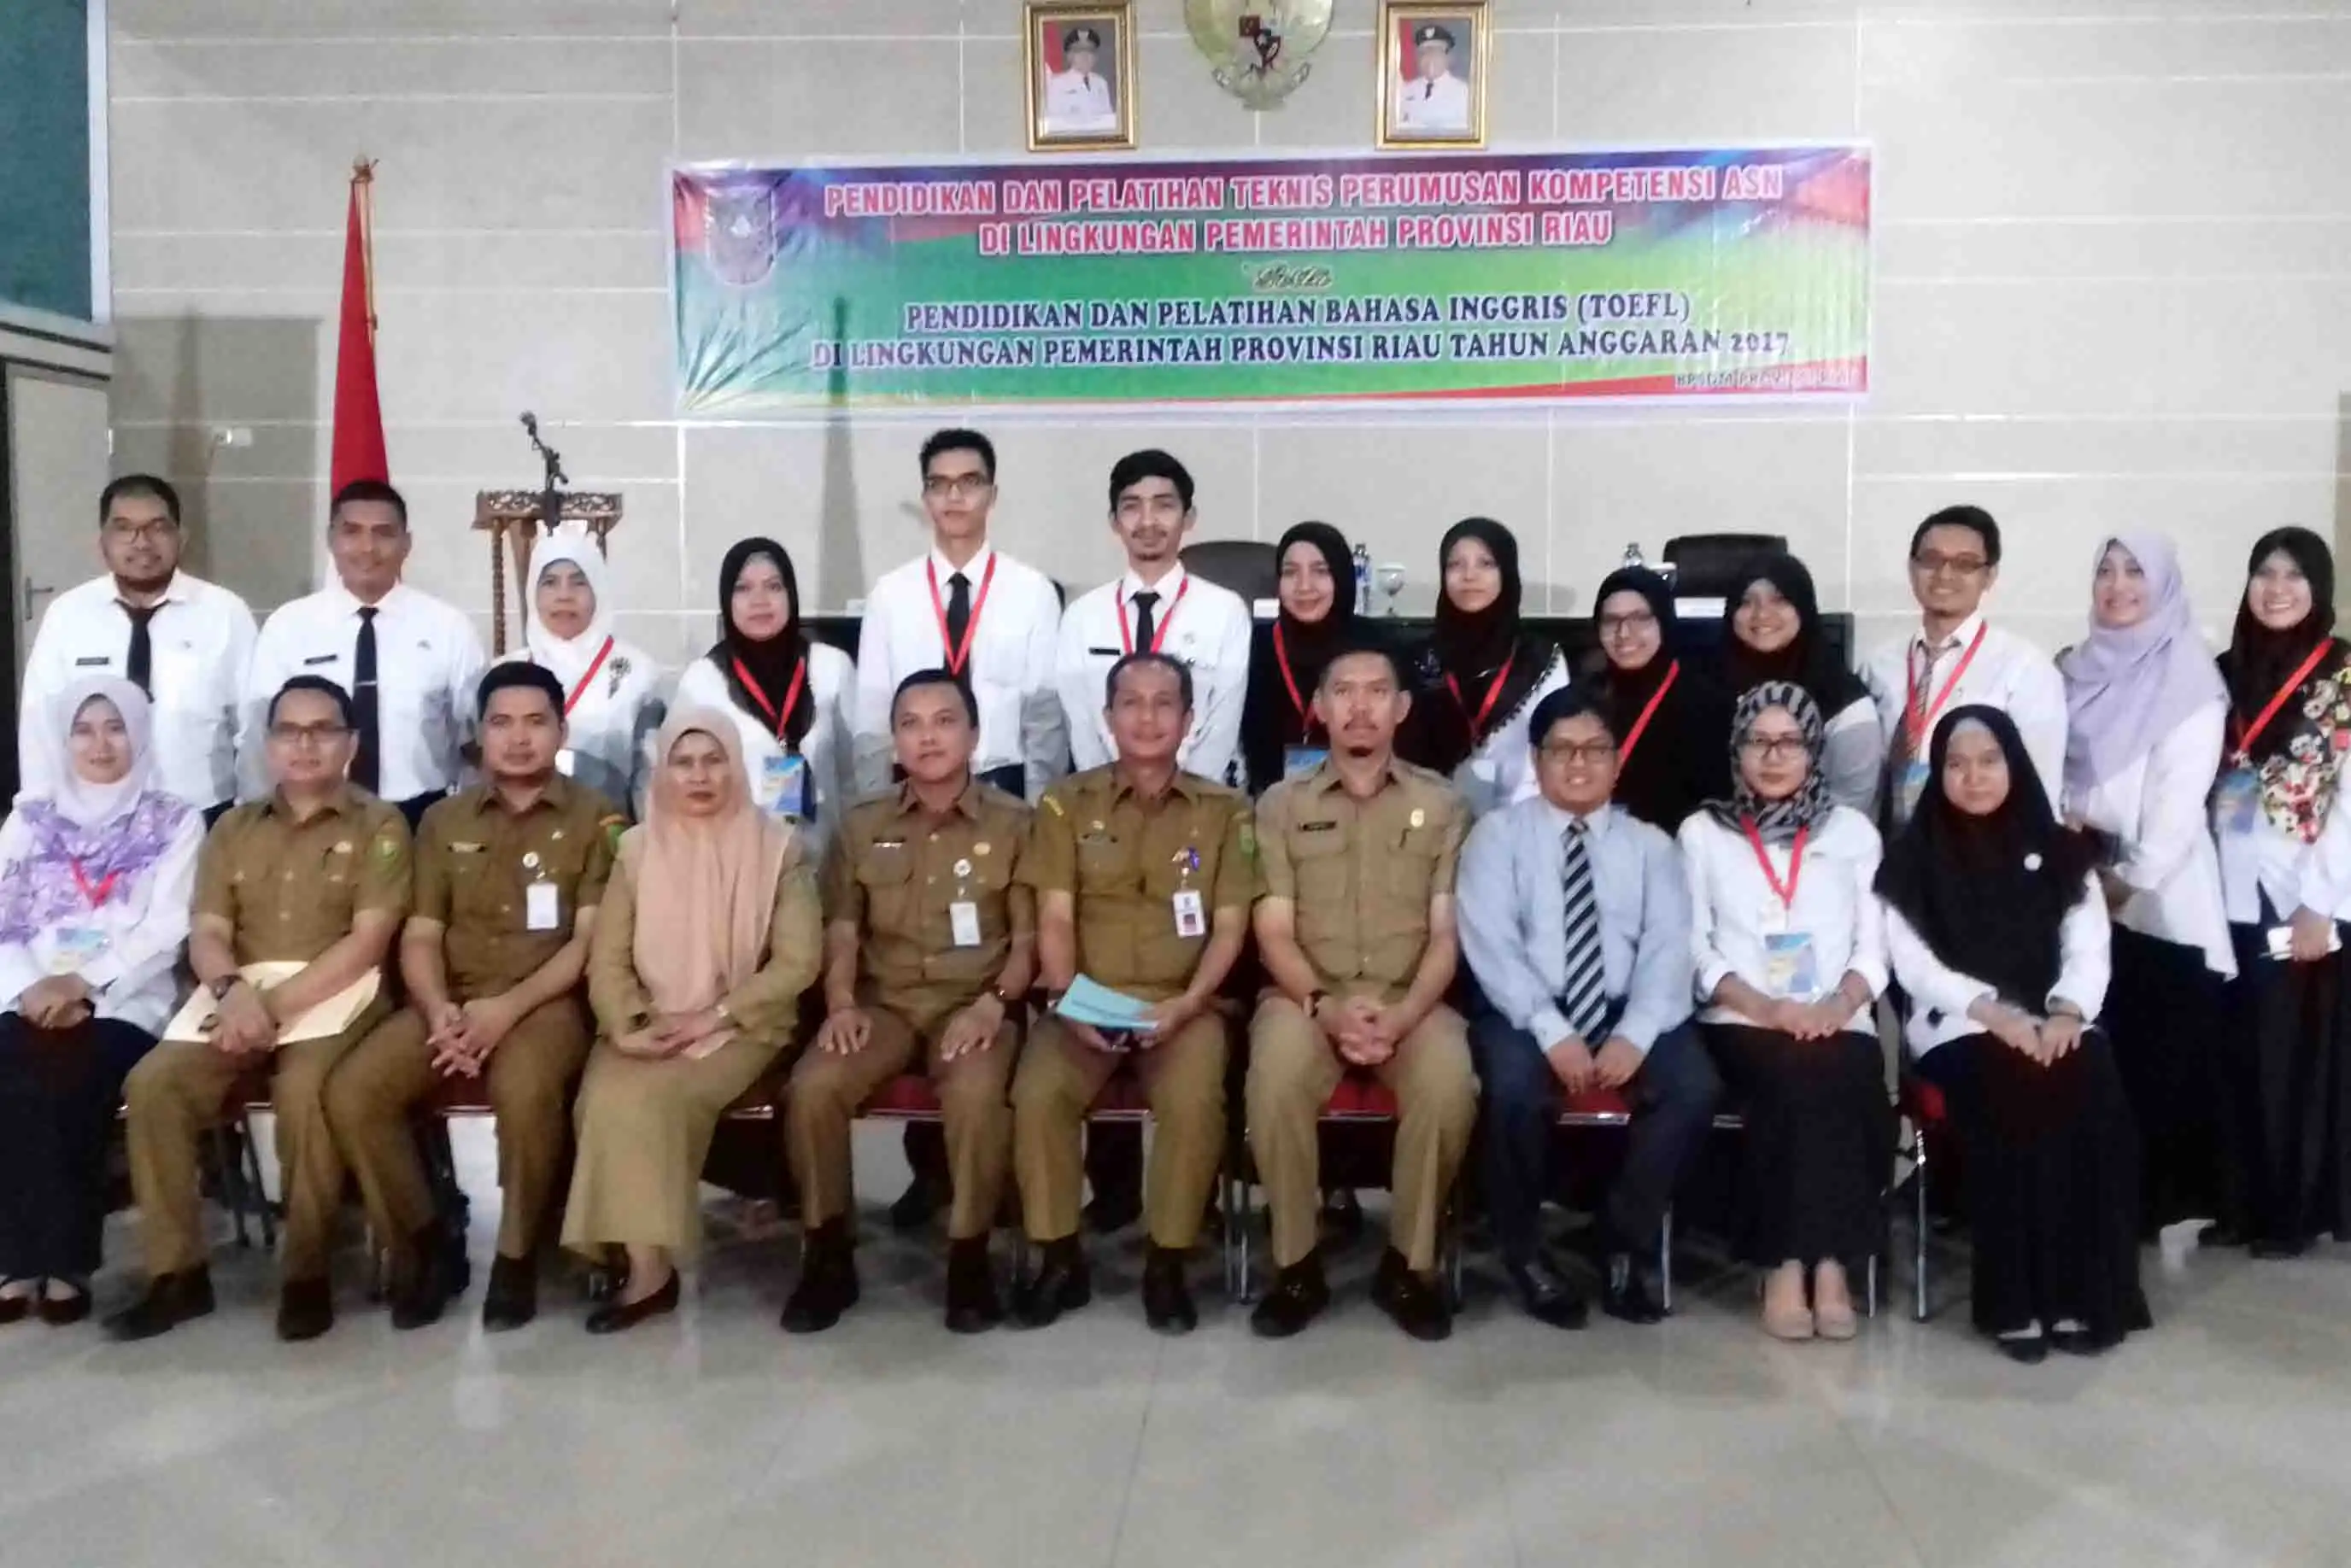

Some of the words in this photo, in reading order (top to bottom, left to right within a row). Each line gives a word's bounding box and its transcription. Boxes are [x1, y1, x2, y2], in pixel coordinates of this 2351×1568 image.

[825, 183, 995, 215] PENDIDIKAN
[1004, 181, 1061, 212] DAN
[1070, 178, 1223, 211] PELATIHAN
[1230, 175, 1332, 208] TEKNIS
[1341, 173, 1519, 207] PERUMUSAN
[1530, 167, 1714, 202] KOMPETENSI
[1723, 166, 1782, 200] ASN
[980, 224, 1010, 254] DI
[1018, 220, 1195, 253] LINGKUNGAN
[1205, 216, 1387, 251] PEMERINTAH
[1398, 214, 1533, 248] PROVINSI
[1543, 212, 1611, 245] RIAU
[906, 302, 1082, 330] PENDIDIKAN
[1090, 301, 1148, 327] DAN
[1158, 299, 1316, 325] PELATIHAN
[1325, 296, 1440, 323] BAHASA
[1449, 295, 1568, 321] INGGRIS
[1577, 291, 1690, 323] (TOEFL)
[813, 341, 841, 367] DI
[850, 339, 1035, 367] LINGKUNGAN
[1043, 336, 1222, 364] PEMERINTAH
[1230, 334, 1363, 360] PROVINSI
[1371, 332, 1442, 359] RIAU
[1450, 331, 1548, 357] TAHUN
[1557, 329, 1721, 356] ANGGARAN
[1731, 331, 1789, 355] 2017
